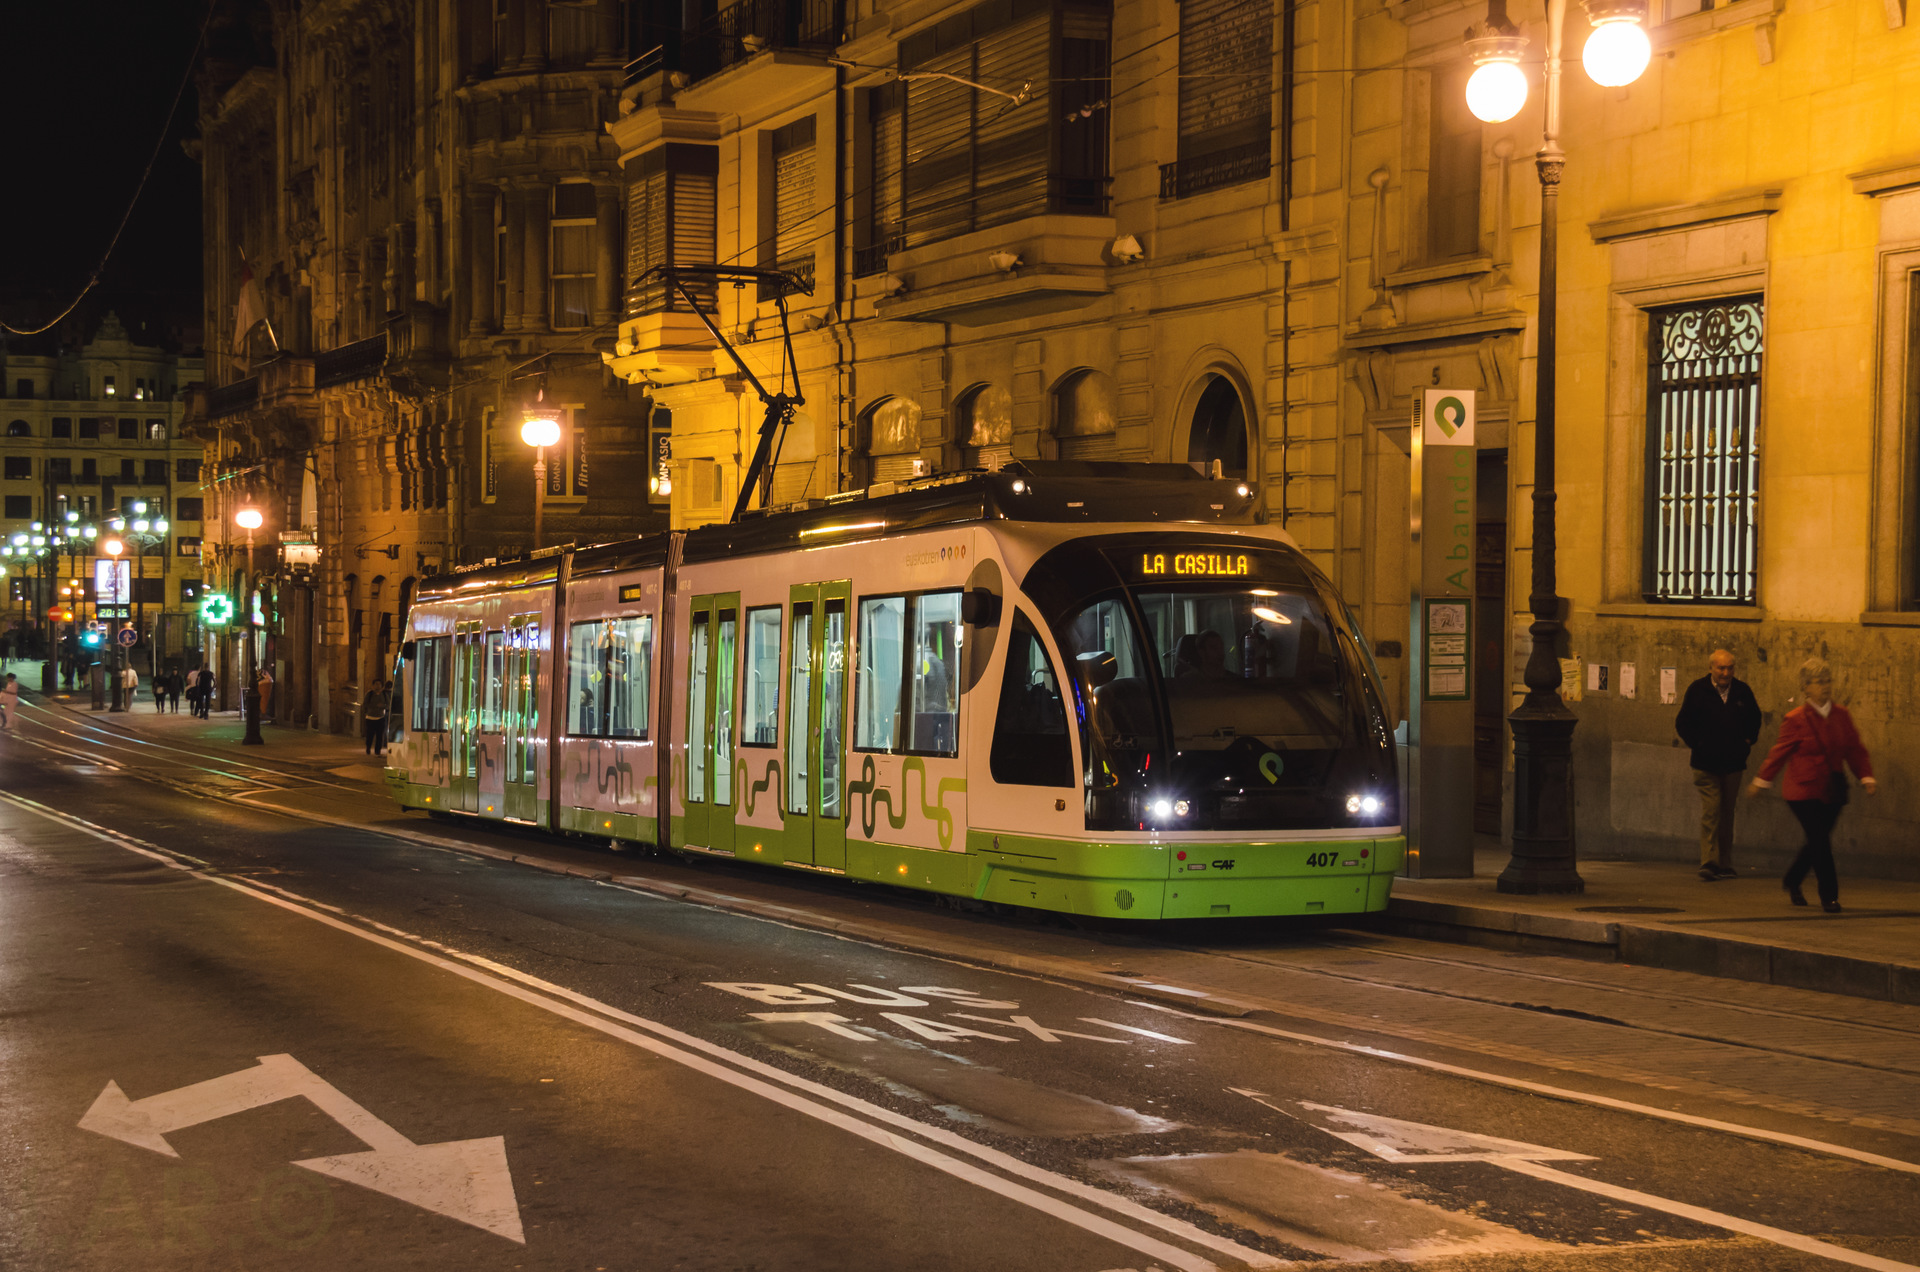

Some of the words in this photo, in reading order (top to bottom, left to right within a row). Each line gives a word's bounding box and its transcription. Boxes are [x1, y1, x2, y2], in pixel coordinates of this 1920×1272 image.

[1432, 367, 1441, 386] 5
[659, 436, 669, 485] IMNASIO
[1445, 449, 1470, 592] Abando
[1142, 553, 1165, 575] LA
[1174, 554, 1248, 576] CASILLA
[1306, 852, 1339, 868] 407
[700, 981, 1020, 1010] BUS
[746, 1011, 1196, 1045] TAXI
